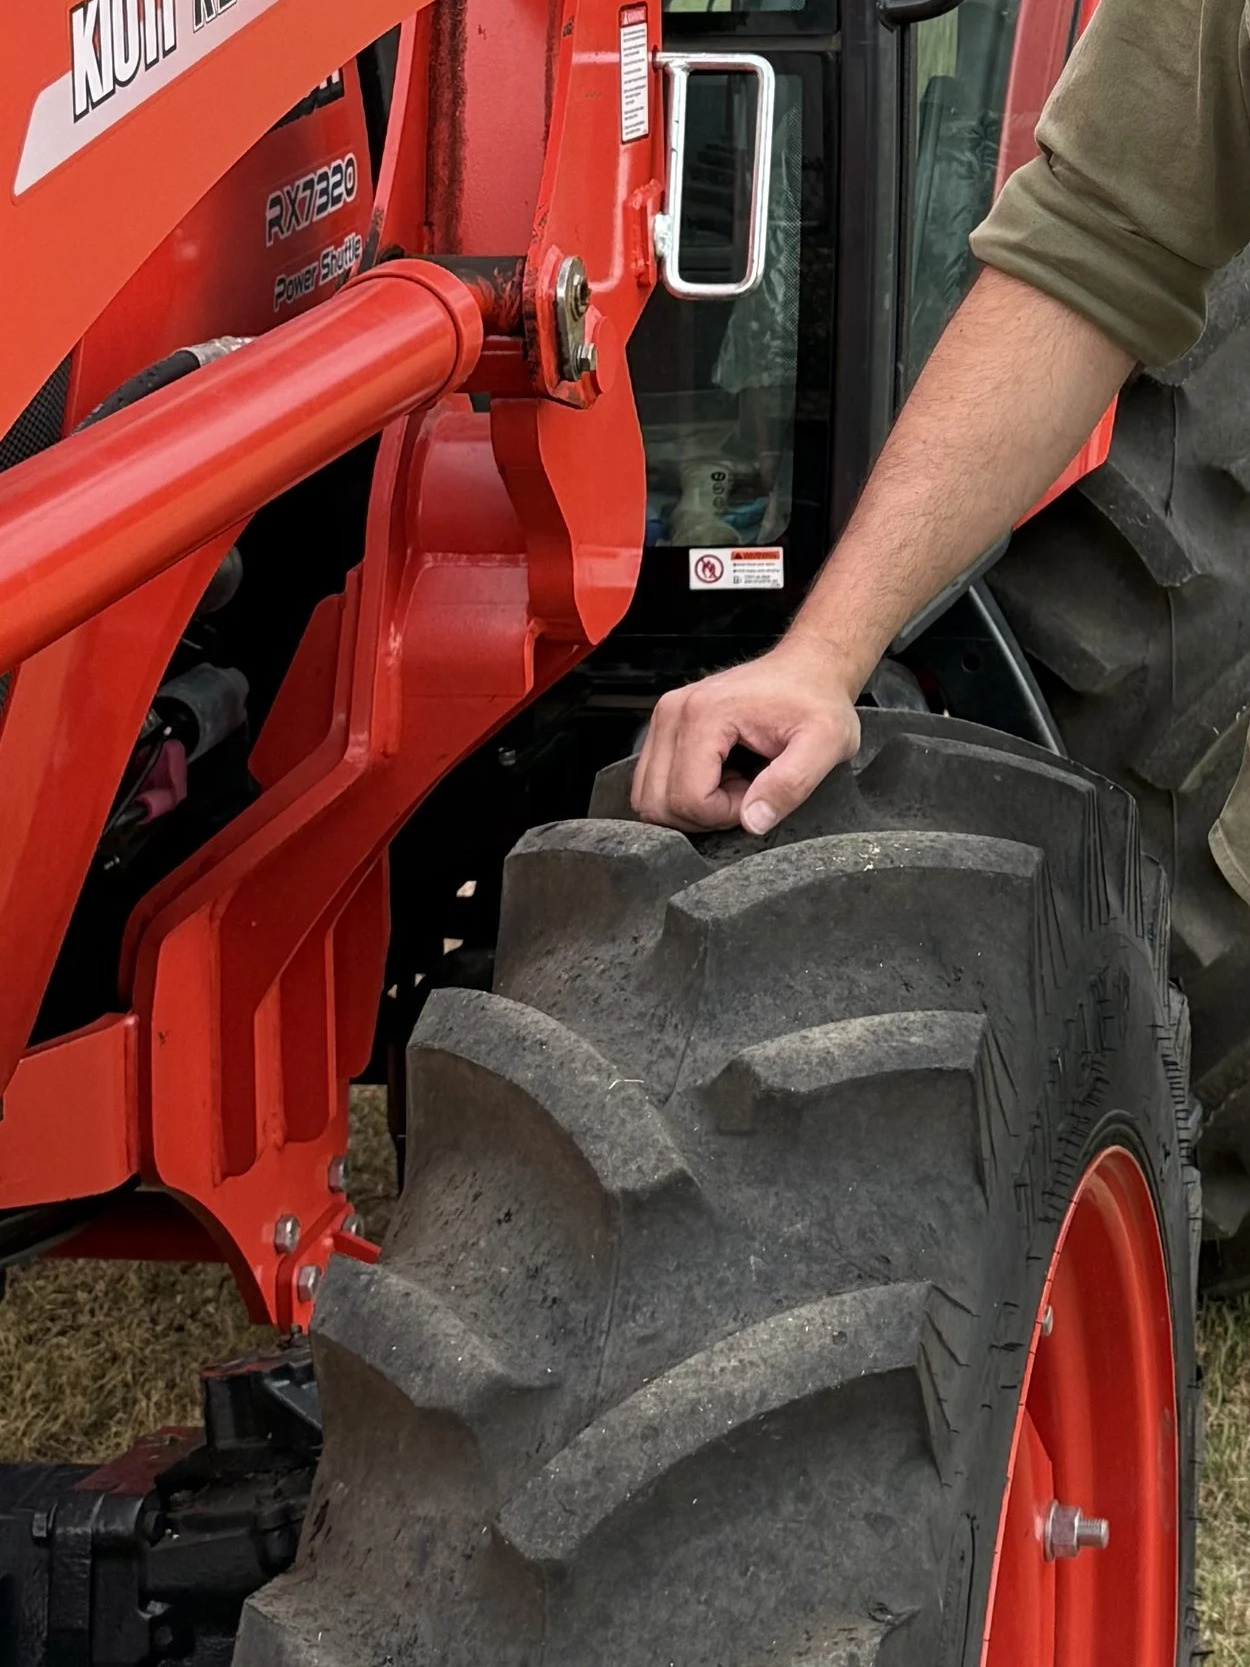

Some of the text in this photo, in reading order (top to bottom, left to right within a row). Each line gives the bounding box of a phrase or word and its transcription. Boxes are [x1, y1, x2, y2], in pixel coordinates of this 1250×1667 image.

[266, 152, 357, 247] RX7320
[274, 232, 362, 312] Power Shuttle
